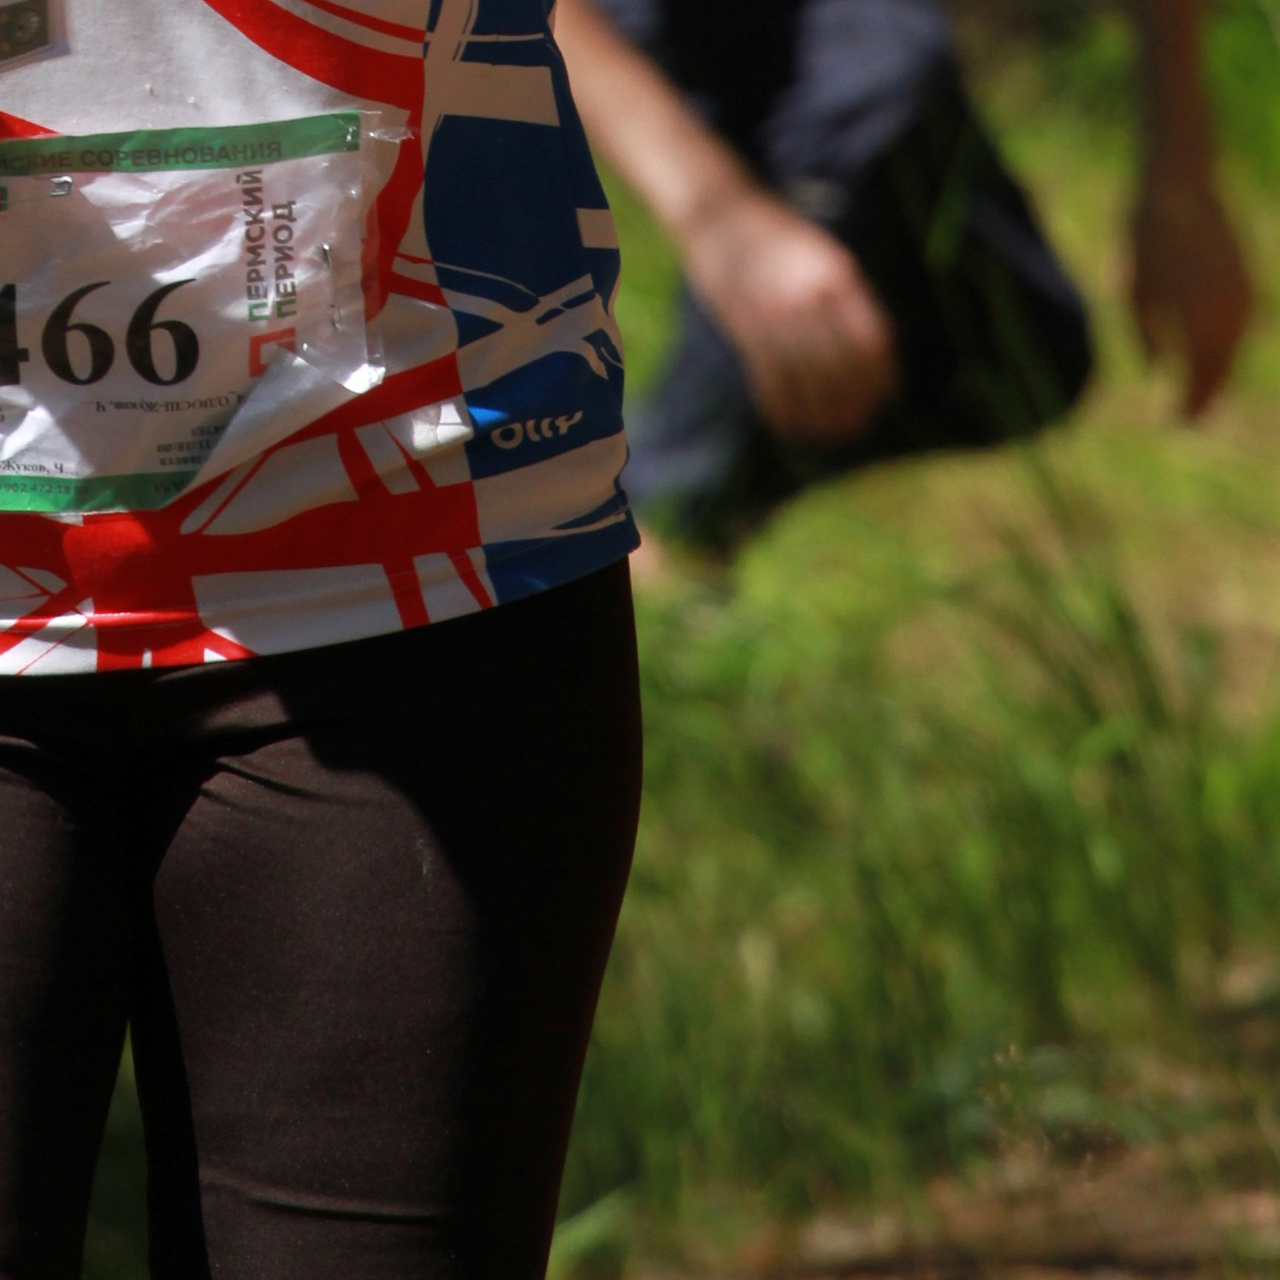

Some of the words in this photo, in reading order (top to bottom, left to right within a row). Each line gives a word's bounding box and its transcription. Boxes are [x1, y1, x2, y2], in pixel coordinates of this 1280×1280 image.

[80, 139, 282, 168] СОРЕВНОВАНИЯ
[236, 169, 270, 322] ПЕРМСКИЙ
[272, 200, 297, 318] ПЕРИОД
[490, 409, 583, 449] OLLY
